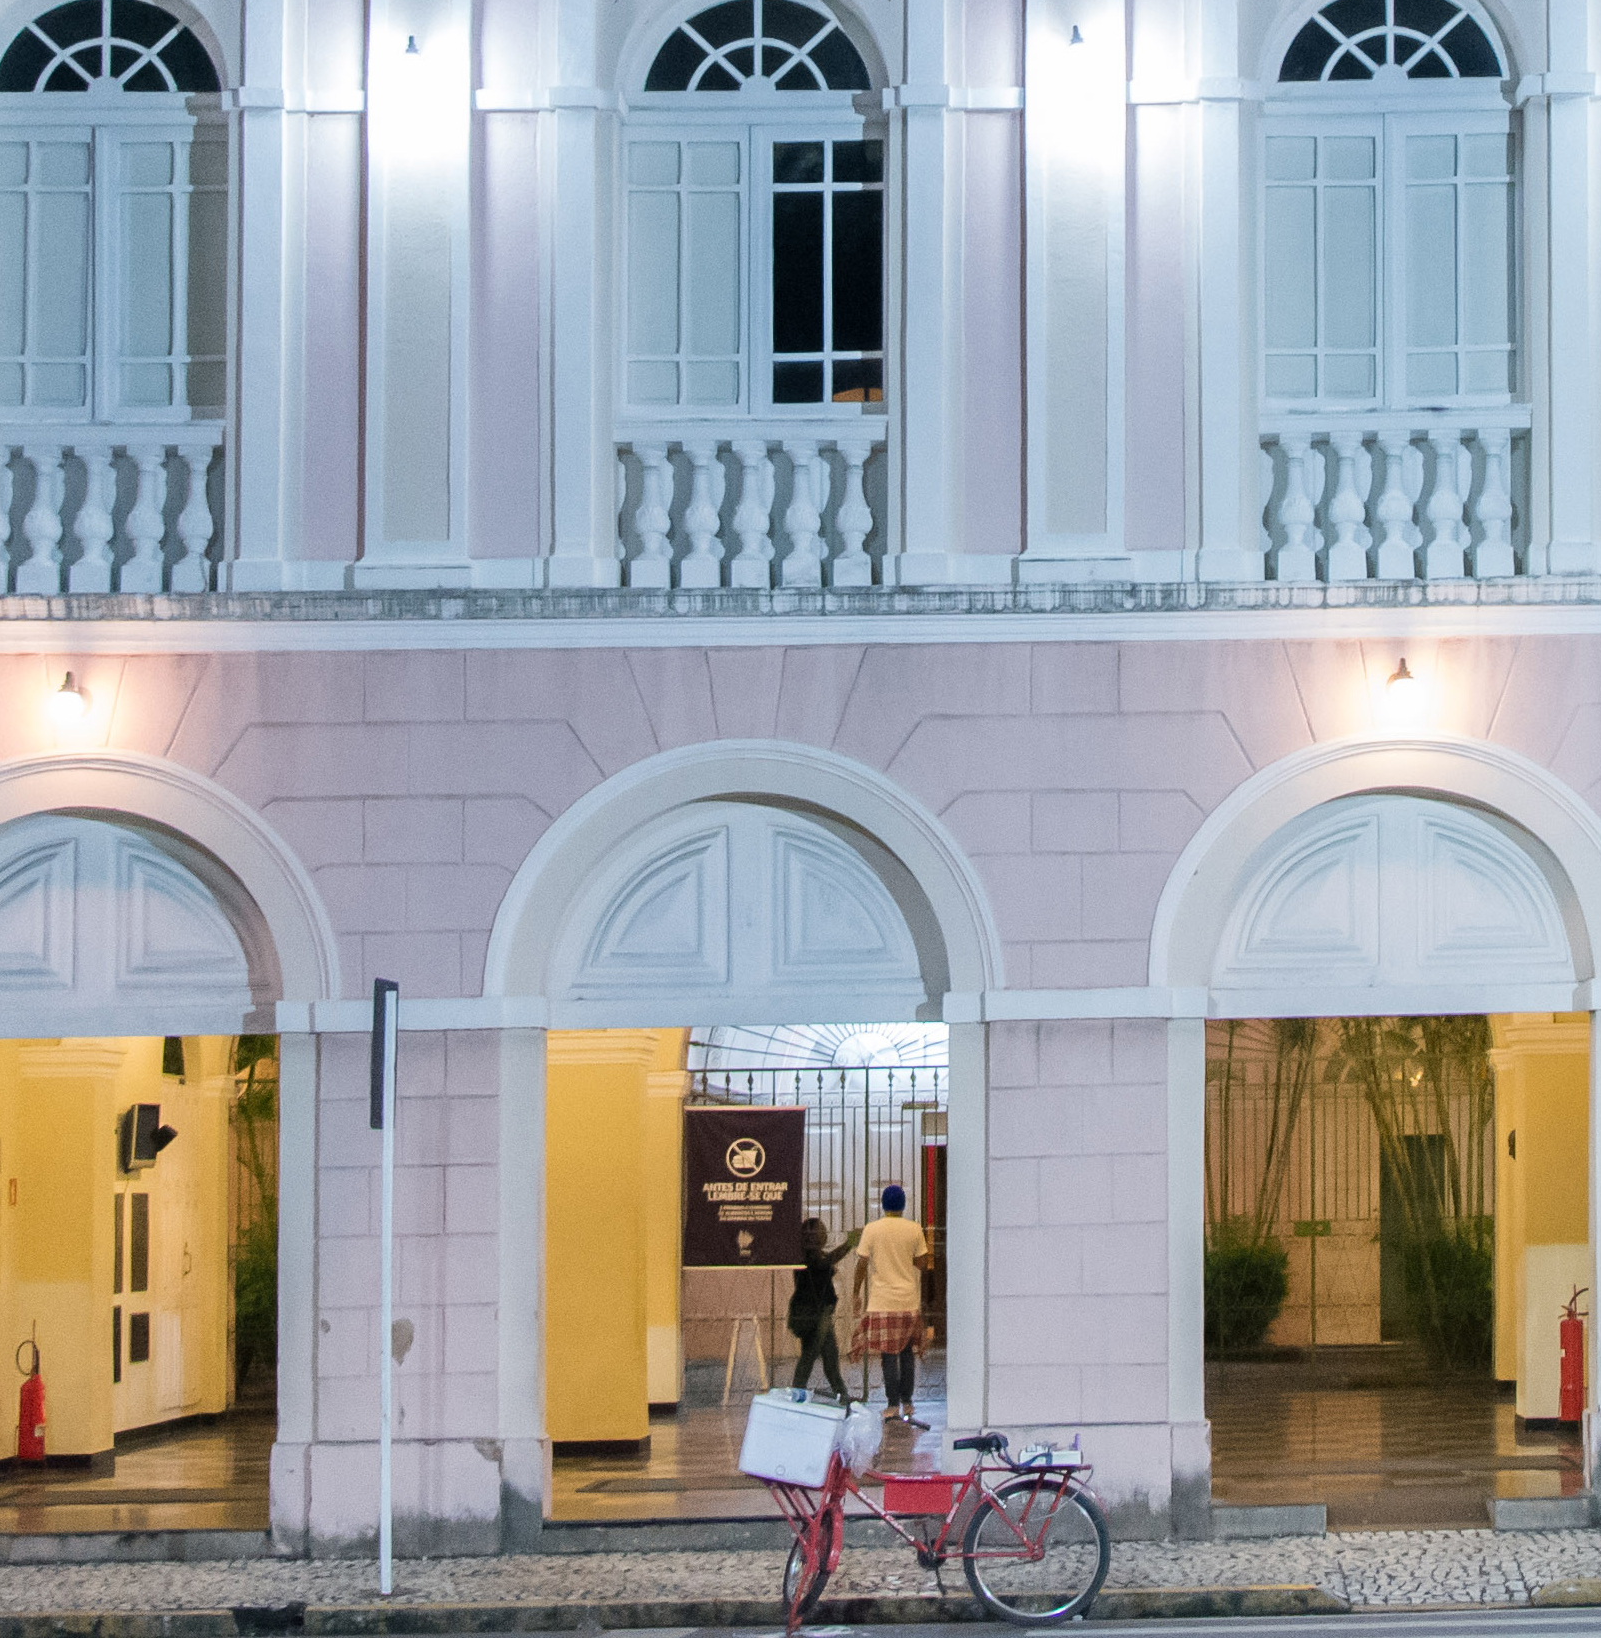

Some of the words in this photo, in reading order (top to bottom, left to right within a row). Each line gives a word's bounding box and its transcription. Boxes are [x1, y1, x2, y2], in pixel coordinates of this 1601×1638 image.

[703, 1183, 734, 1192] ANTES
[735, 1182, 748, 1192] DE
[750, 1182, 788, 1191] ENTRAR
[708, 1191, 761, 1201] LEMBRE-SE
[763, 1191, 783, 1201] QUE
